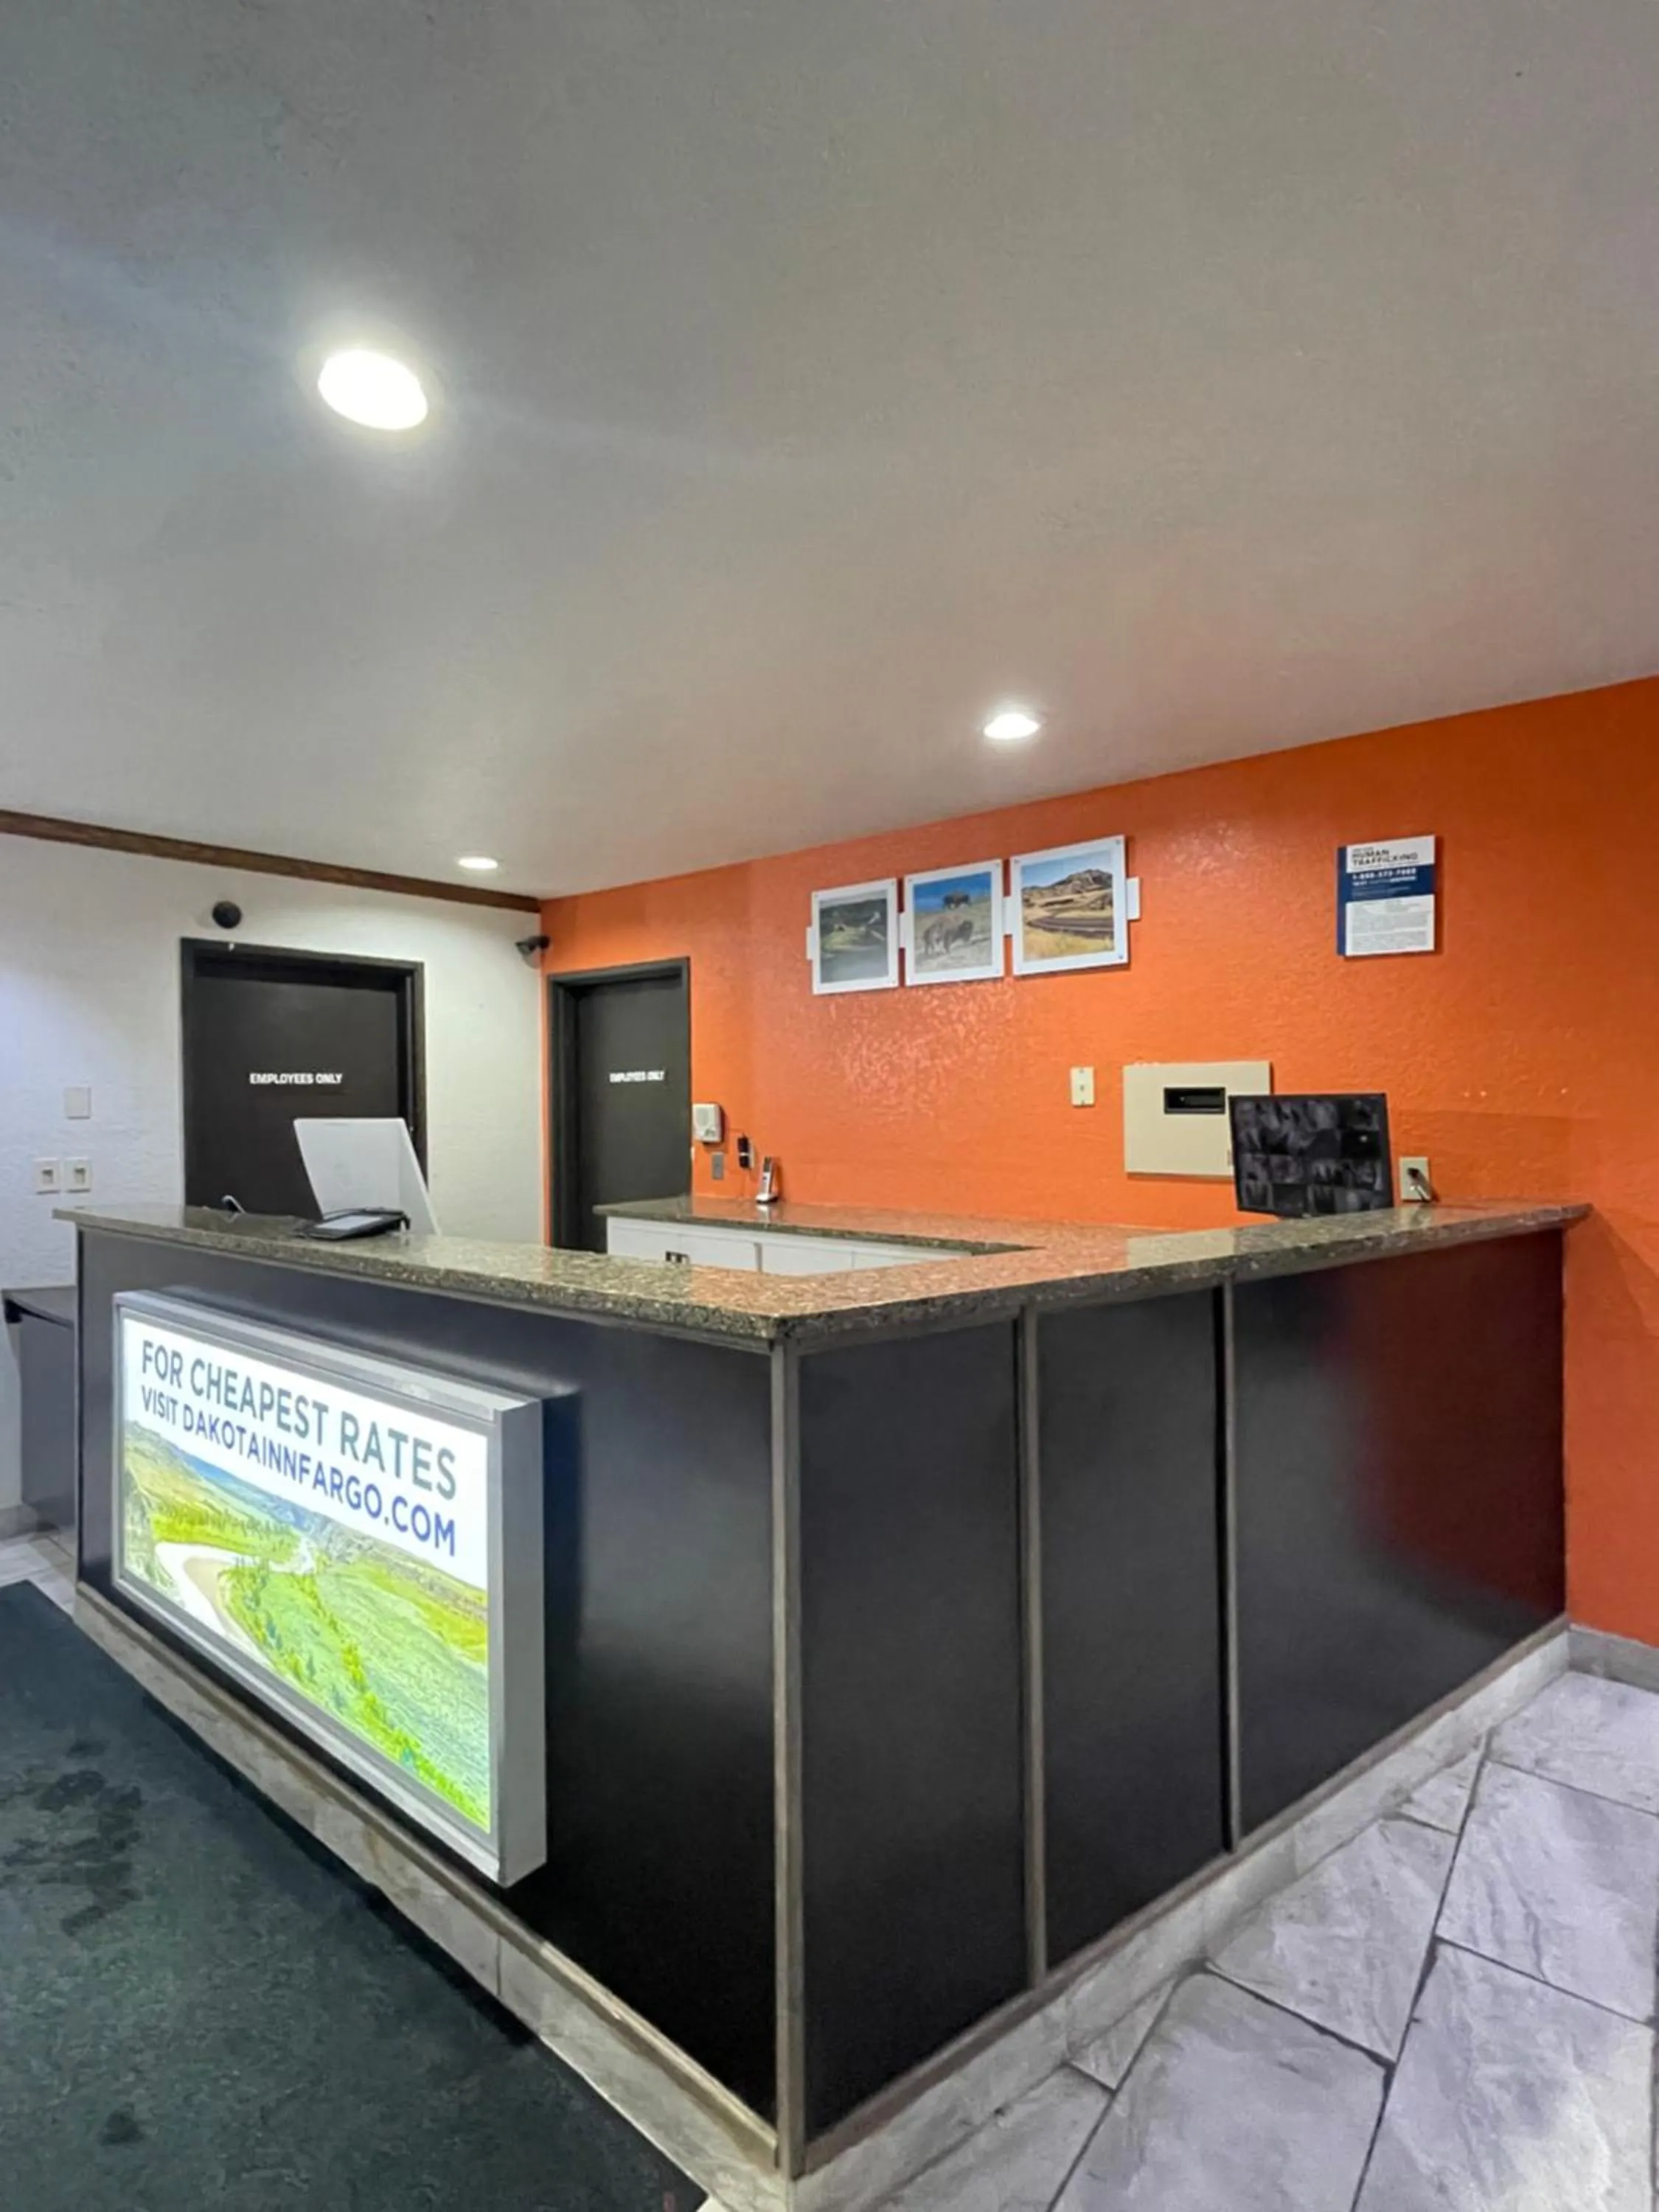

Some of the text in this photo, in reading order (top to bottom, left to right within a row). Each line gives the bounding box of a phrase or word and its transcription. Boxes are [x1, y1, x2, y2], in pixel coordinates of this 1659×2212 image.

[249, 1073, 343, 1085] EMPLOYEES ONLY
[142, 1340, 456, 1500] FOR CHEAPEST RATES
[142, 1385, 456, 1557] VISIT DAKOTAINNFARGO.COM
